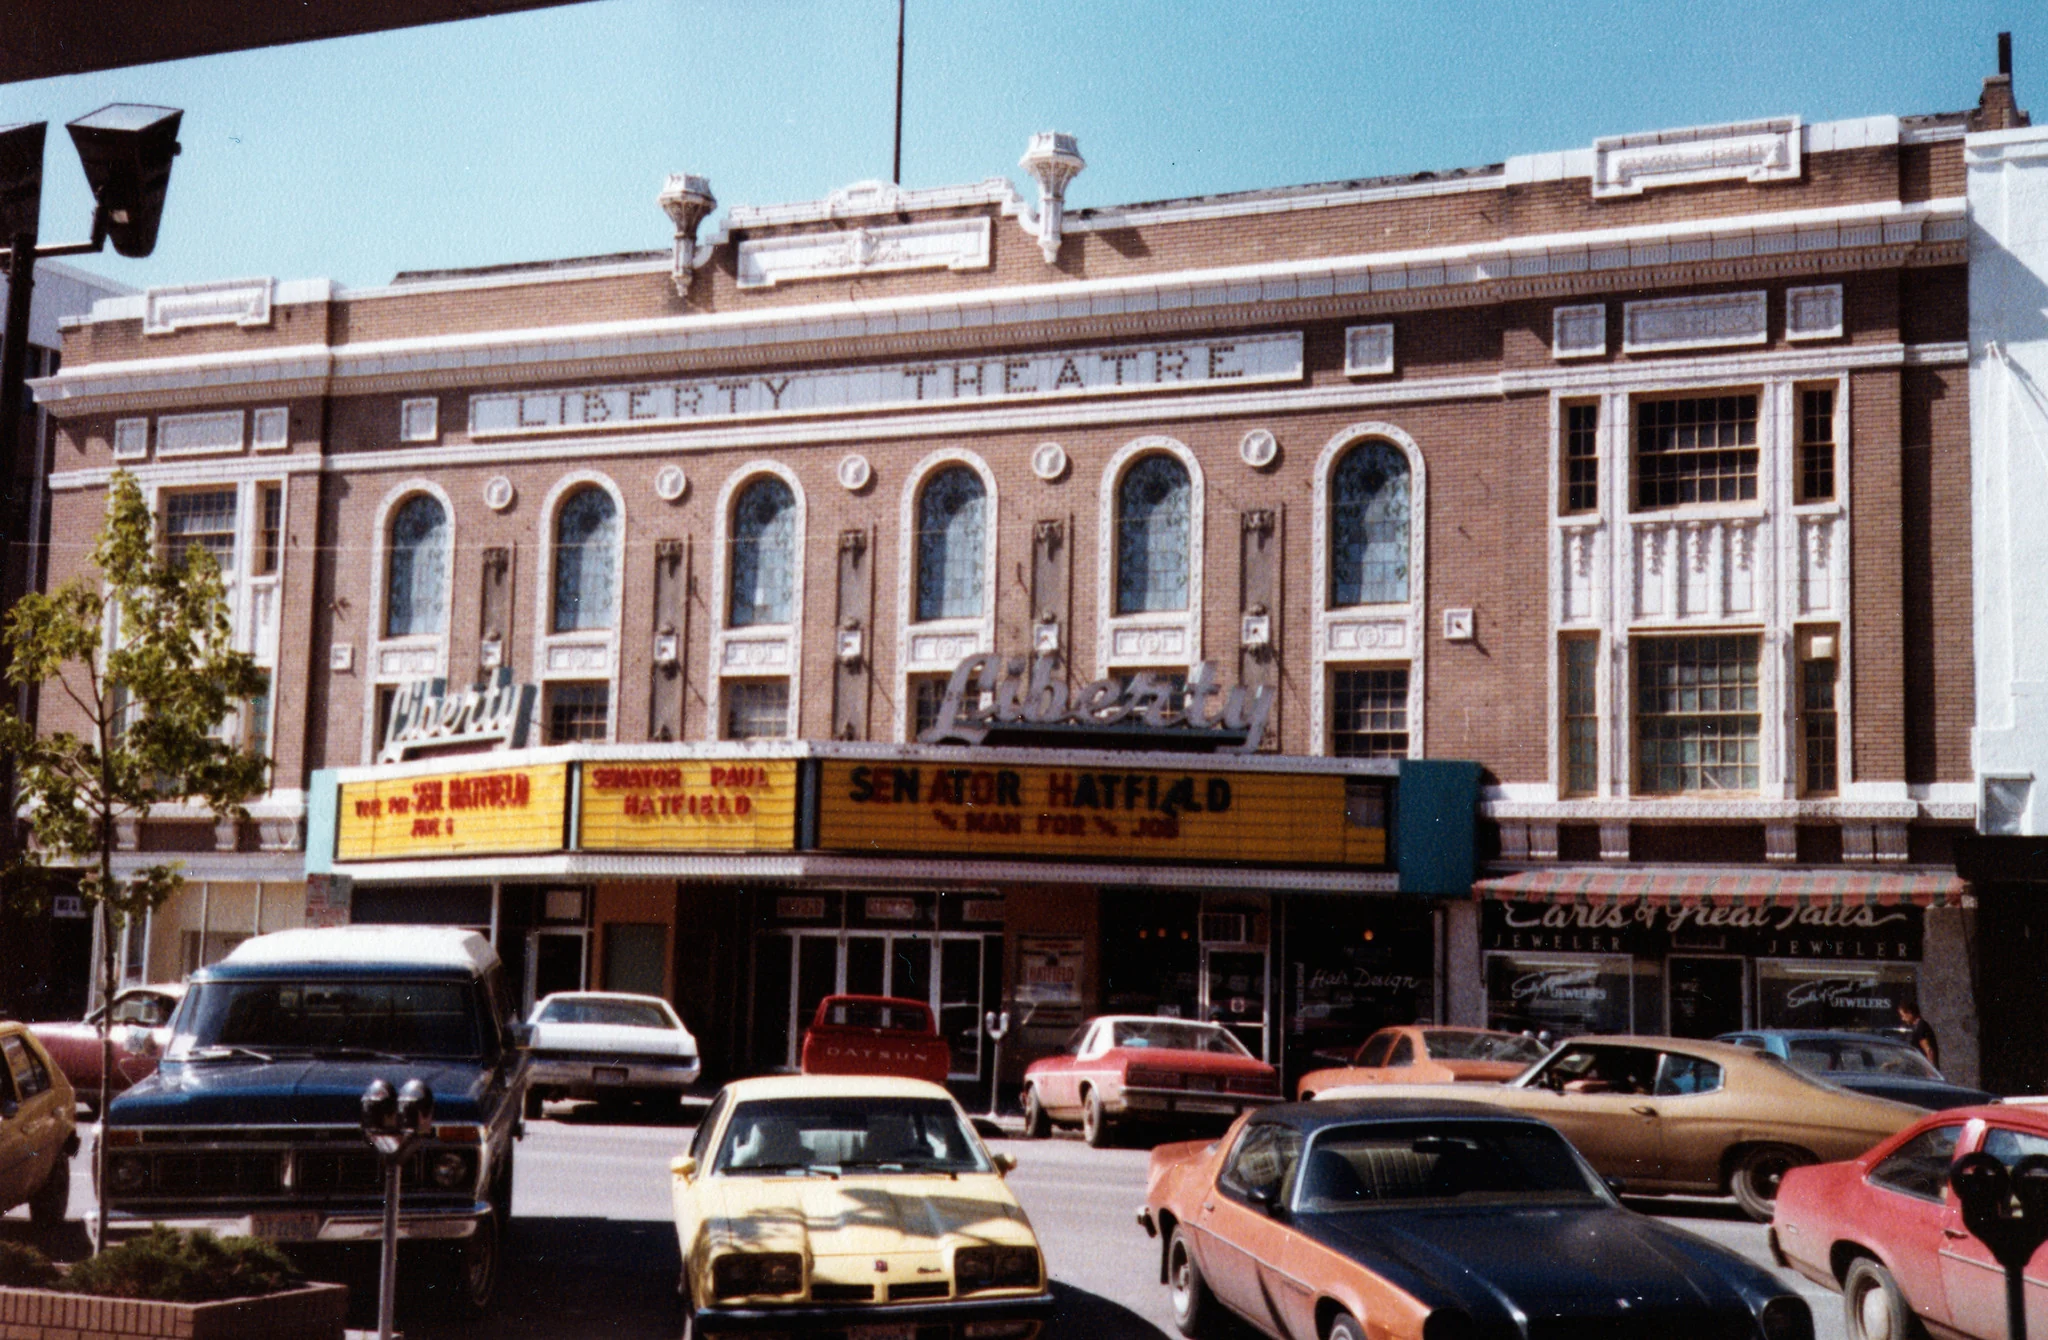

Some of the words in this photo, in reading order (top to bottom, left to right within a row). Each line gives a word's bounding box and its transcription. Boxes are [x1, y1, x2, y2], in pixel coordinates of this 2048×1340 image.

[518, 378, 790, 427] LIBERTY
[903, 345, 1244, 400] THEATRE
[916, 652, 1276, 754] Liberty
[592, 767, 681, 789] SENATOR
[710, 766, 769, 788] PAUL
[623, 794, 751, 816] HATFIELD
[1037, 814, 1085, 836] FOR
[1493, 934, 1620, 950] JEWELER
[1769, 939, 1908, 957] JEWELER
[1831, 997, 1892, 1009] JEWELERS
[826, 1046, 928, 1061] DATSUN
